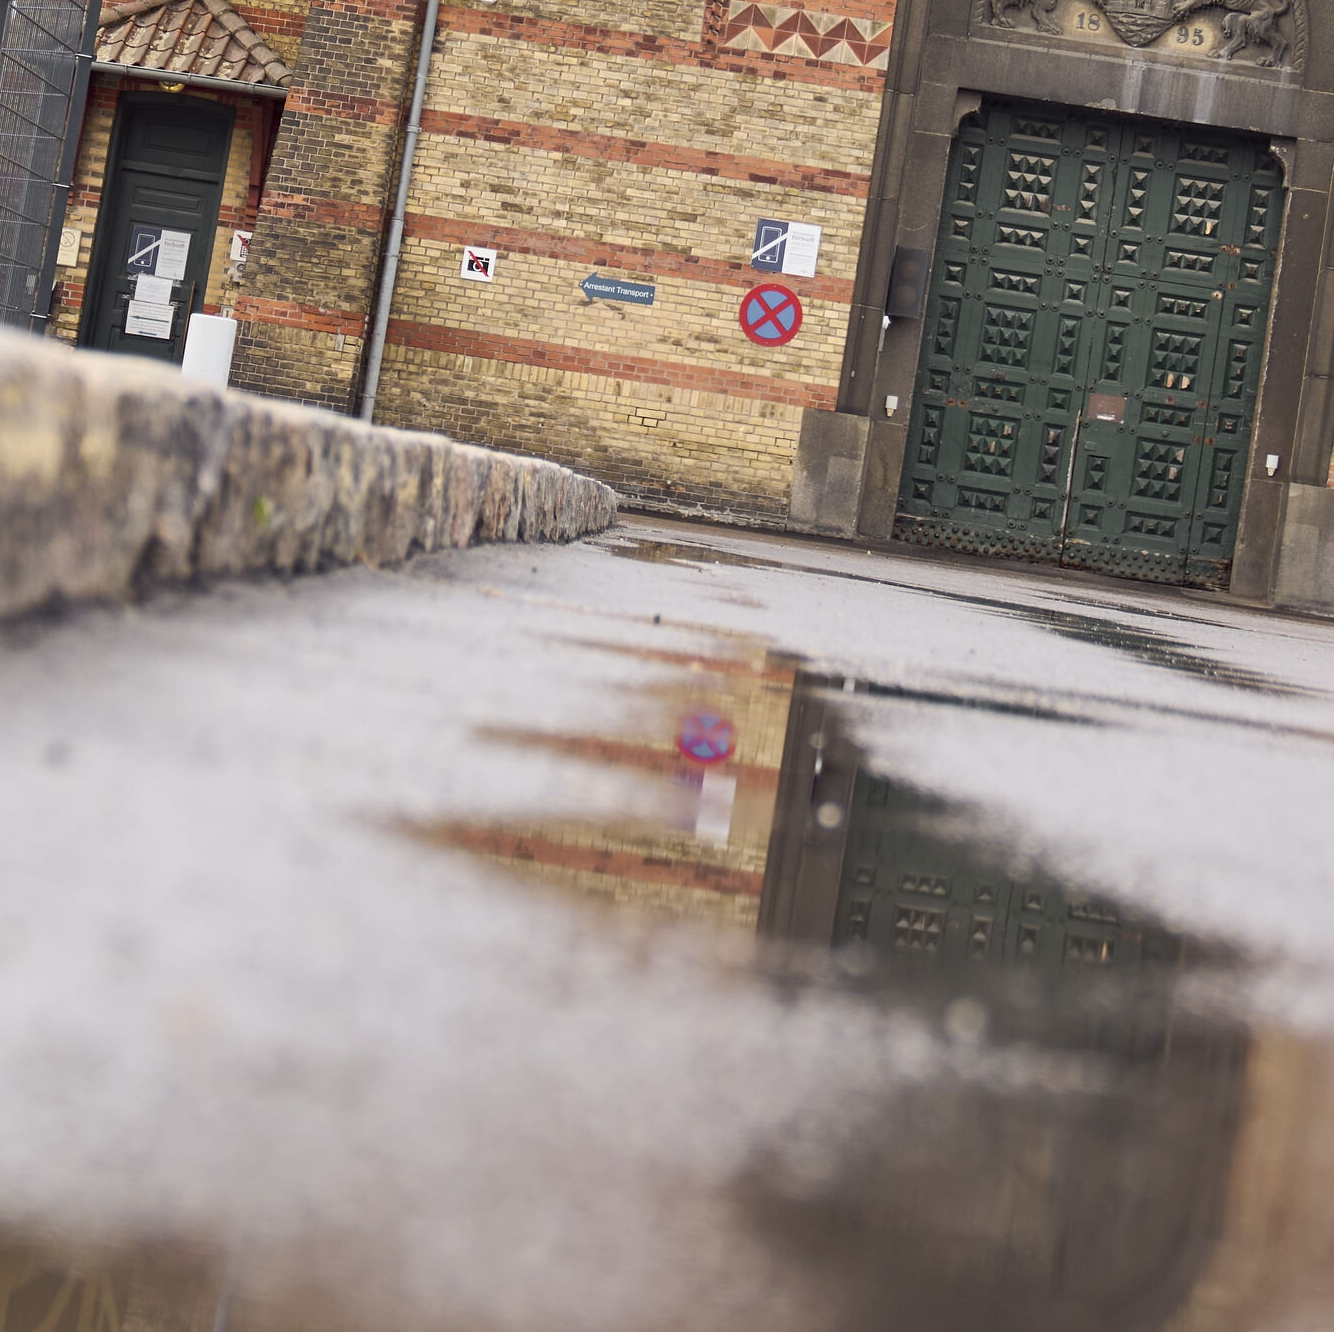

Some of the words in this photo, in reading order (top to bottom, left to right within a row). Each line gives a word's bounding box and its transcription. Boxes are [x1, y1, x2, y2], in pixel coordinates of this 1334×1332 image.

[1076, 11, 1101, 31] 18
[1177, 26, 1204, 46] 95
[583, 281, 615, 293] Arrestant
[616, 286, 649, 298] Transport
